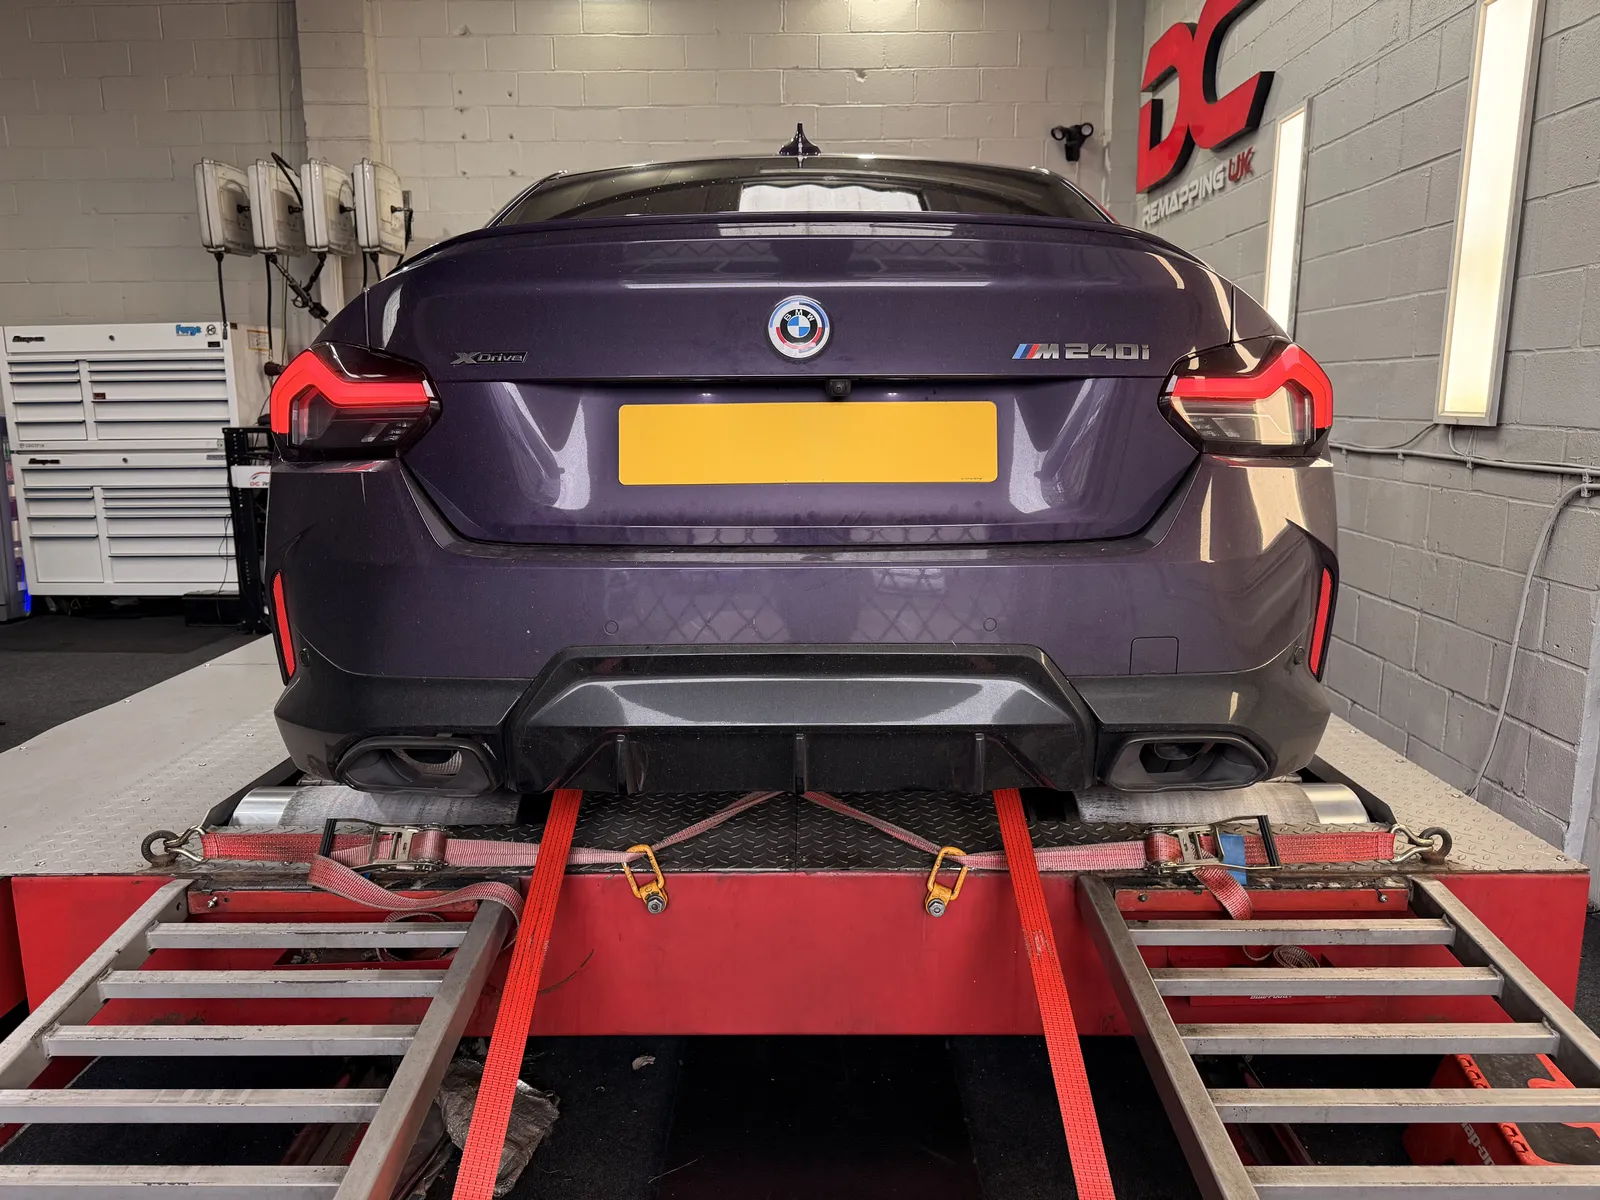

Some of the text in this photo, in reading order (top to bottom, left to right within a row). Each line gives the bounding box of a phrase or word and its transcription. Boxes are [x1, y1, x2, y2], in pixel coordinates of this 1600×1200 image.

[1136, 0, 1275, 194] DC
[1141, 147, 1256, 227] REMAPPING UK
[783, 309, 816, 322] BMW
